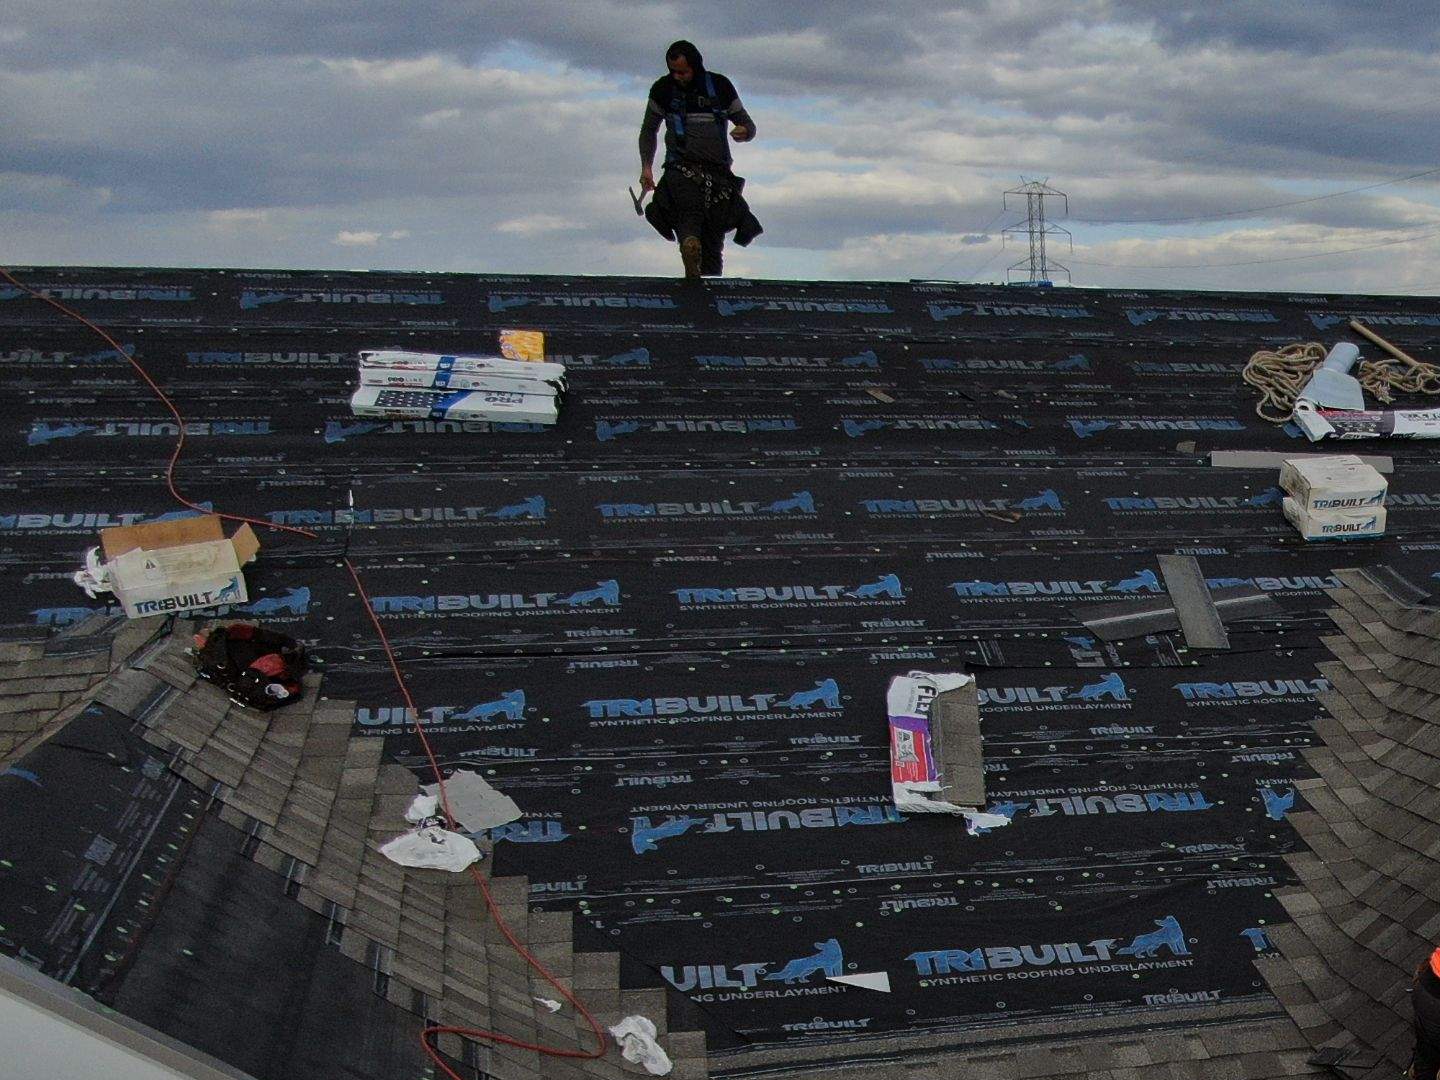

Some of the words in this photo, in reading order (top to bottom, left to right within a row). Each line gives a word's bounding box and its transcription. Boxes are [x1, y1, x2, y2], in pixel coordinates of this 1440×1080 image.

[1313, 497, 1366, 509] TRIBUILT
[1322, 523, 1362, 533] TRIBUILT
[670, 584, 851, 602] TRIBUILT
[946, 580, 1112, 597] TRIBUILT
[134, 590, 214, 616] TRIBUILT
[369, 590, 557, 611] TRIBUILT
[450, 611, 513, 619] ROOFING
[515, 607, 622, 617] UNDERLAYMENT
[582, 693, 782, 718] TRIBUILT
[1036, 703, 1133, 713] UNDERLAYMENT
[1187, 699, 1249, 709] SYNTHETIC
[411, 722, 526, 733] UNDERLAYMENT
[589, 717, 667, 729] SYNTHETIC
[672, 716, 733, 726] ROOFING
[737, 711, 844, 724] UNDERLAYMENT
[789, 734, 862, 746] TRIBUILT
[1067, 784, 1127, 794] ROOFING
[1129, 781, 1200, 792] SYNTHETIC
[630, 801, 748, 814] UNDERLAYMENT
[751, 797, 817, 808] ROOFING
[1029, 790, 1215, 818] TRIBUILT
[856, 860, 937, 874] TRIBUILT
[880, 896, 960, 912] TRIBUILT
[904, 939, 1118, 976] TRIBUILT
[919, 972, 1003, 989] SYNTHETIC
[1007, 966, 1075, 981] ROOFING
[1078, 958, 1195, 976] UNDERLAYMENT
[719, 985, 850, 1003] UNDERLAYMENT
[1144, 988, 1224, 1005] TRIBUILT
[782, 1017, 875, 1034] TRIBUILT
